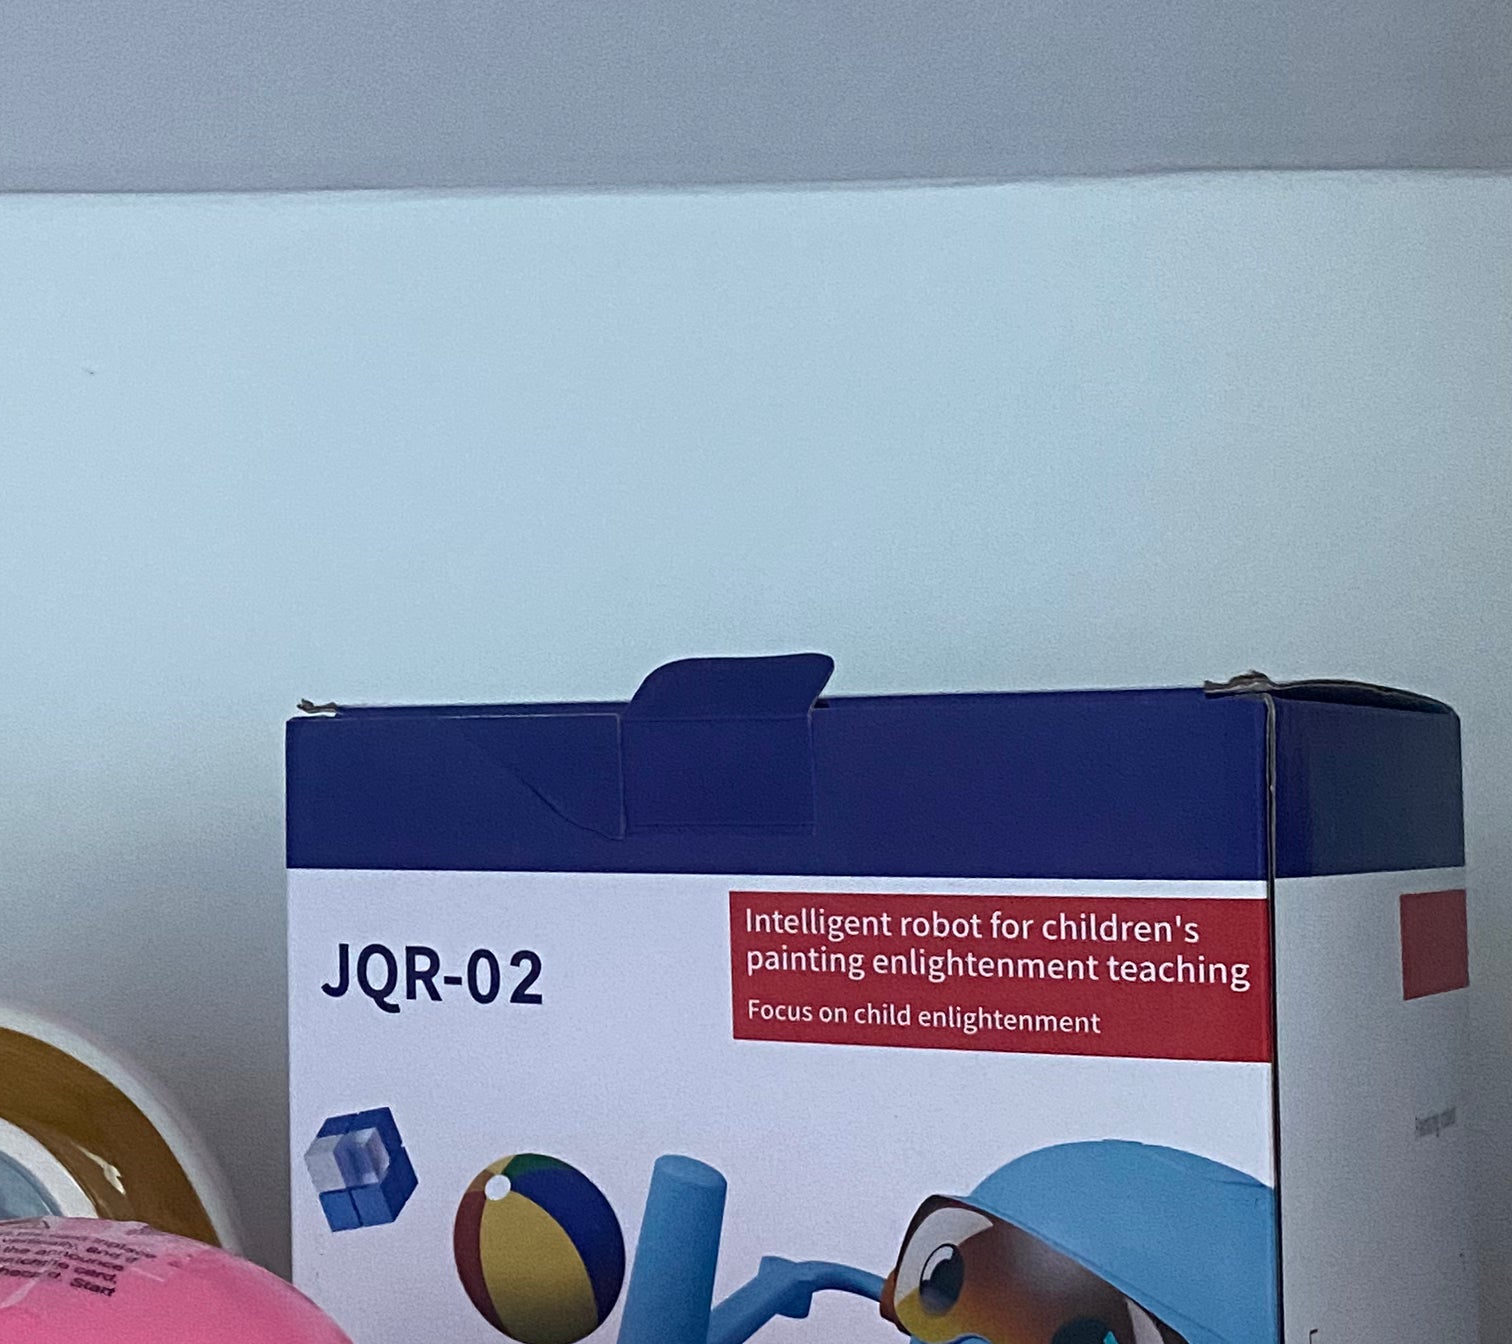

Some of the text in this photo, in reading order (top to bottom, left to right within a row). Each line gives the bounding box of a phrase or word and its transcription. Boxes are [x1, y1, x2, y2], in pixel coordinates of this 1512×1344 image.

[746, 907, 1199, 943] Intelligent robot for children's
[321, 943, 543, 1014] JQR-02
[747, 944, 1251, 992] painting enlightenment teaching
[748, 999, 1101, 1035] Focus on child enlightenment
[70, 1276, 116, 1297] Start
